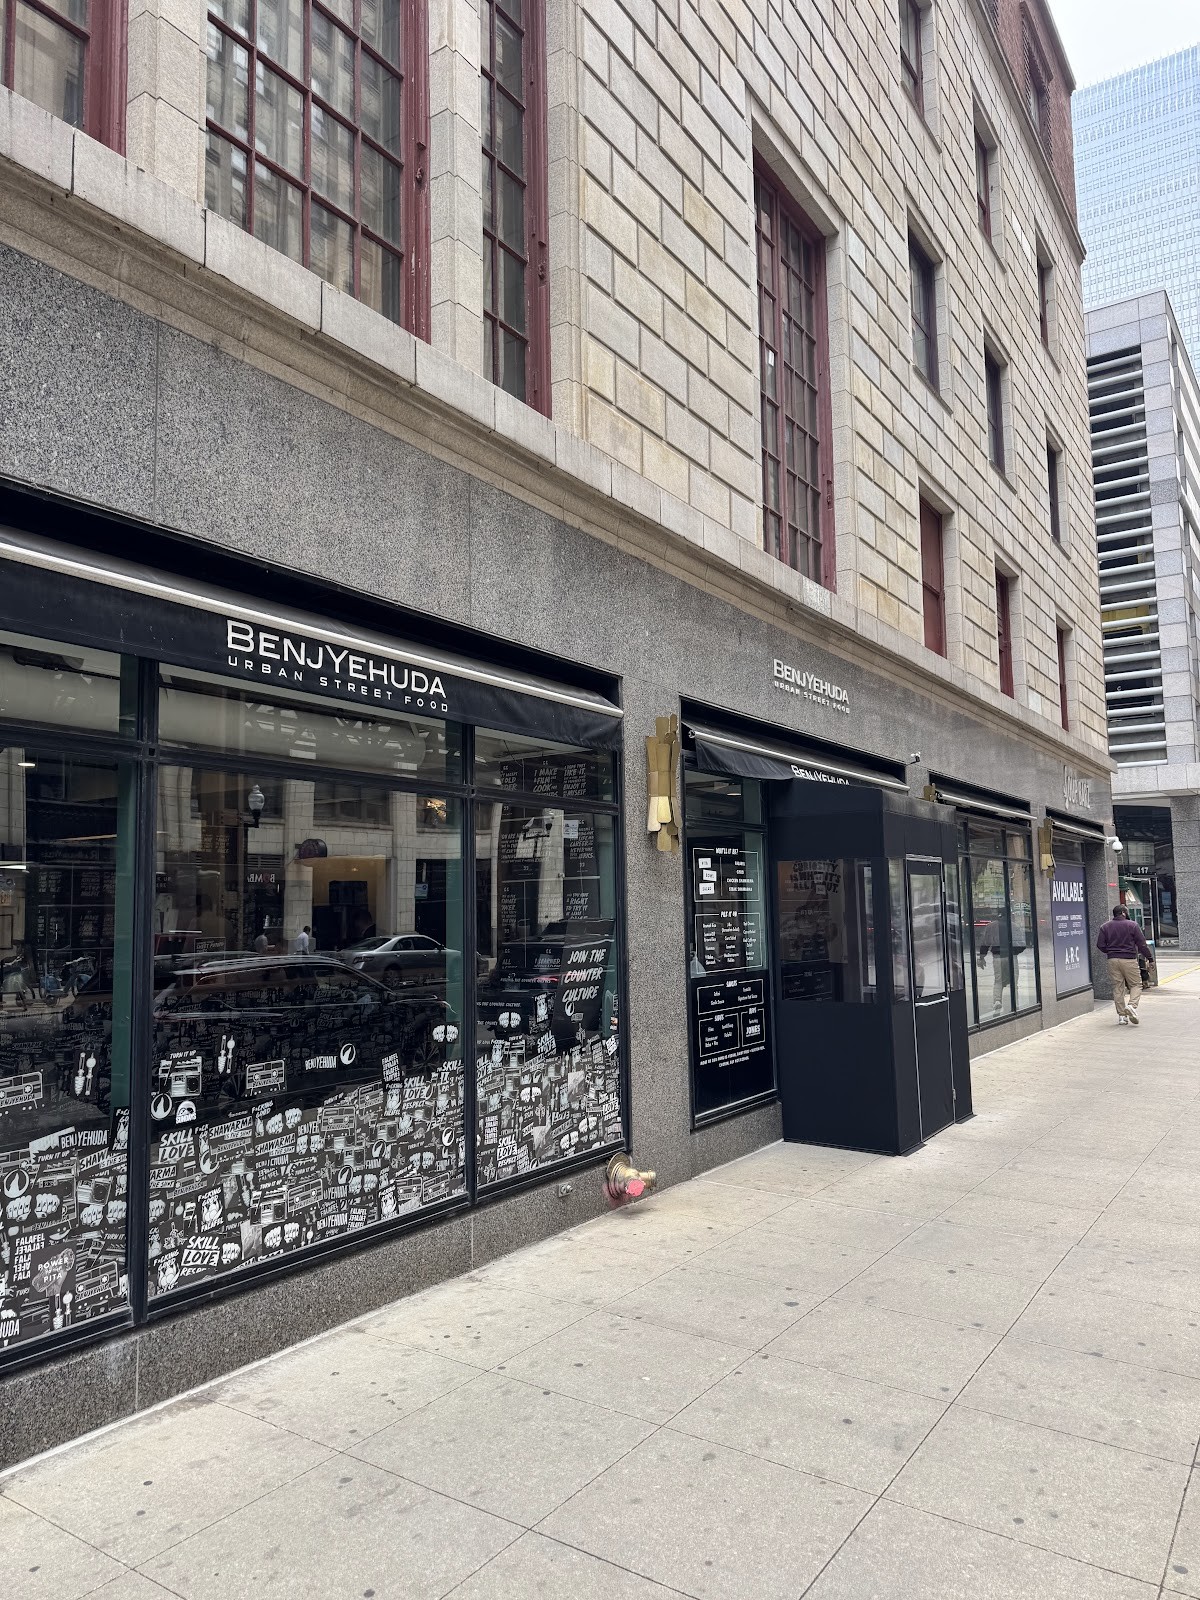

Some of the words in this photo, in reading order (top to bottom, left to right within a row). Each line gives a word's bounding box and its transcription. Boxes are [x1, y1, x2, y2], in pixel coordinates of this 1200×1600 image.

[227, 619, 447, 698] BENJYEHUDA
[228, 655, 303, 681] URBAN
[319, 677, 392, 700] STREET
[404, 696, 448, 712] FOOD
[773, 658, 850, 704] BENJYEHUDA
[774, 681, 800, 695] URBAN
[803, 692, 830, 706] STREET
[833, 702, 850, 714] FOOD
[798, 871, 824, 881] WH
[1052, 881, 1083, 902] AVAILABLE
[568, 950, 589, 964] JOIN
[589, 949, 606, 963] THE
[564, 967, 603, 983] COUNTER
[562, 986, 599, 1002] CULTURE
[209, 1116, 252, 1139] SHAWARMA
[61, 1130, 108, 1149] BENJYEHUDA
[160, 1128, 193, 1147] SKILL
[255, 1133, 295, 1156] SHAWARMA
[38, 1154, 54, 1162] TURN
[159, 1144, 195, 1162] LOVE
[15, 1233, 45, 1247] FALAFEL
[38, 1256, 69, 1271] POWER
[44, 1272, 62, 1283] PITA
